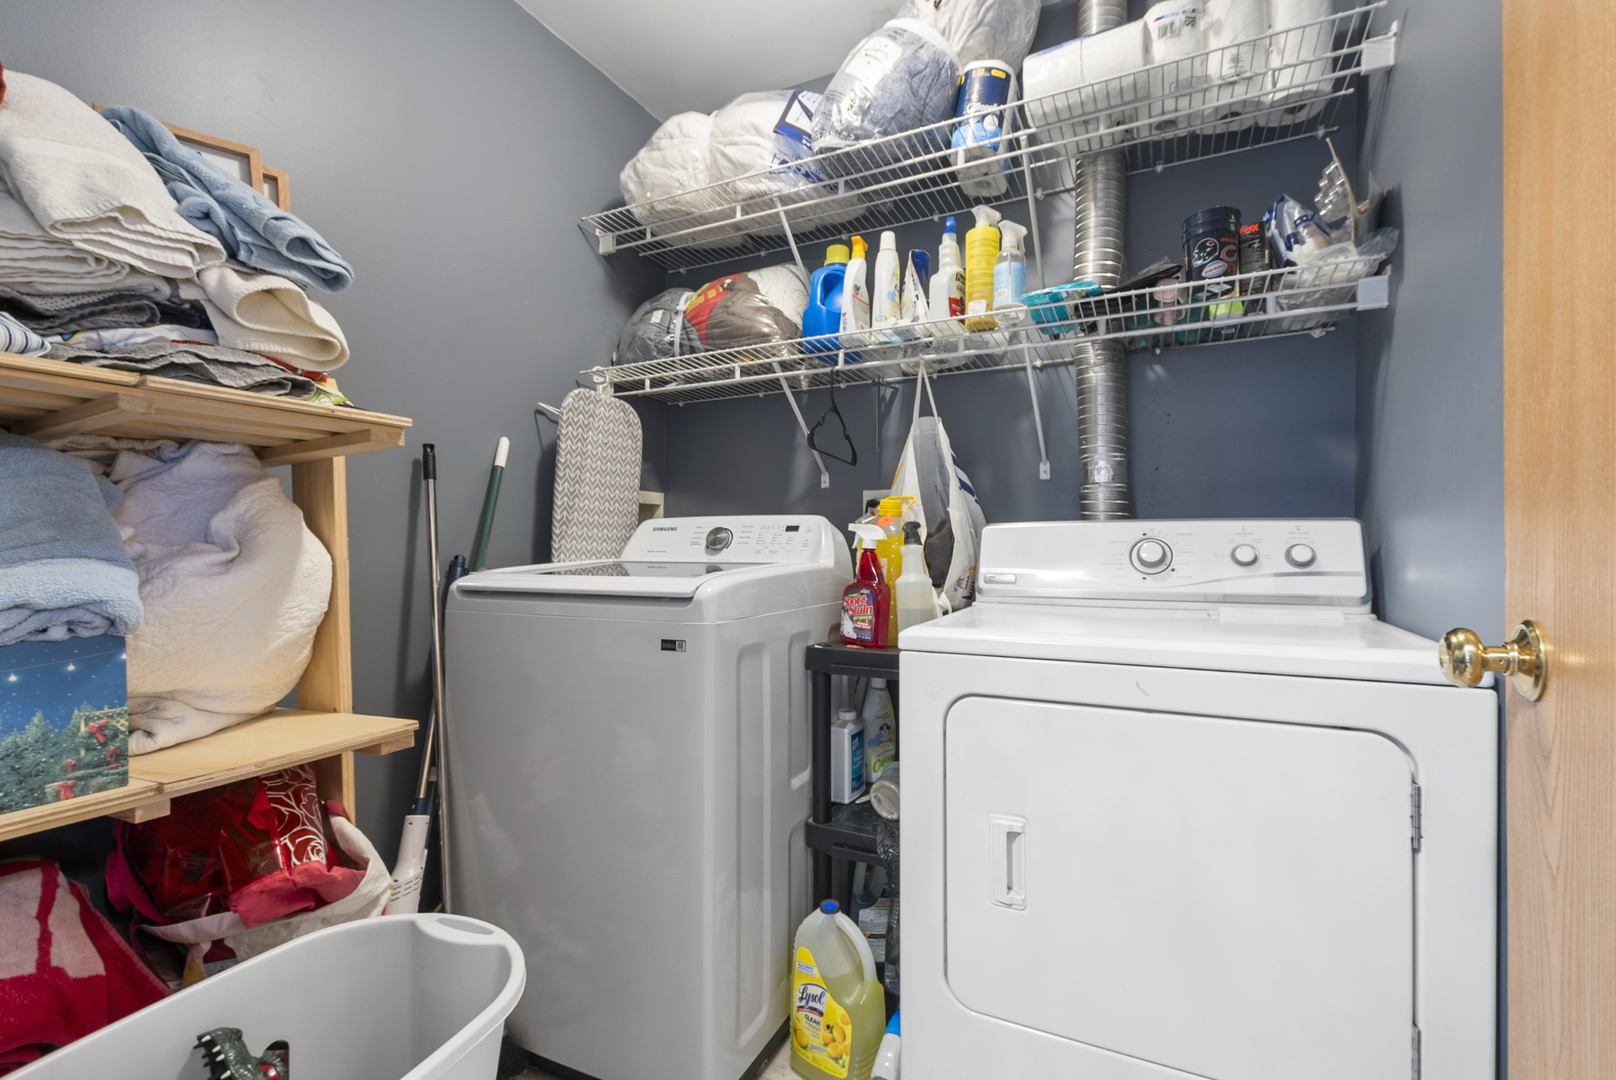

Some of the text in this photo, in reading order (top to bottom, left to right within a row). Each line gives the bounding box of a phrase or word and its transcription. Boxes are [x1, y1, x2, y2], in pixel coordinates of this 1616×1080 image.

[844, 594, 868, 607] Spot &
[848, 604, 874, 615] Stain
[798, 986, 826, 1006] Lysol
[804, 1014, 820, 1026] CLEAN
